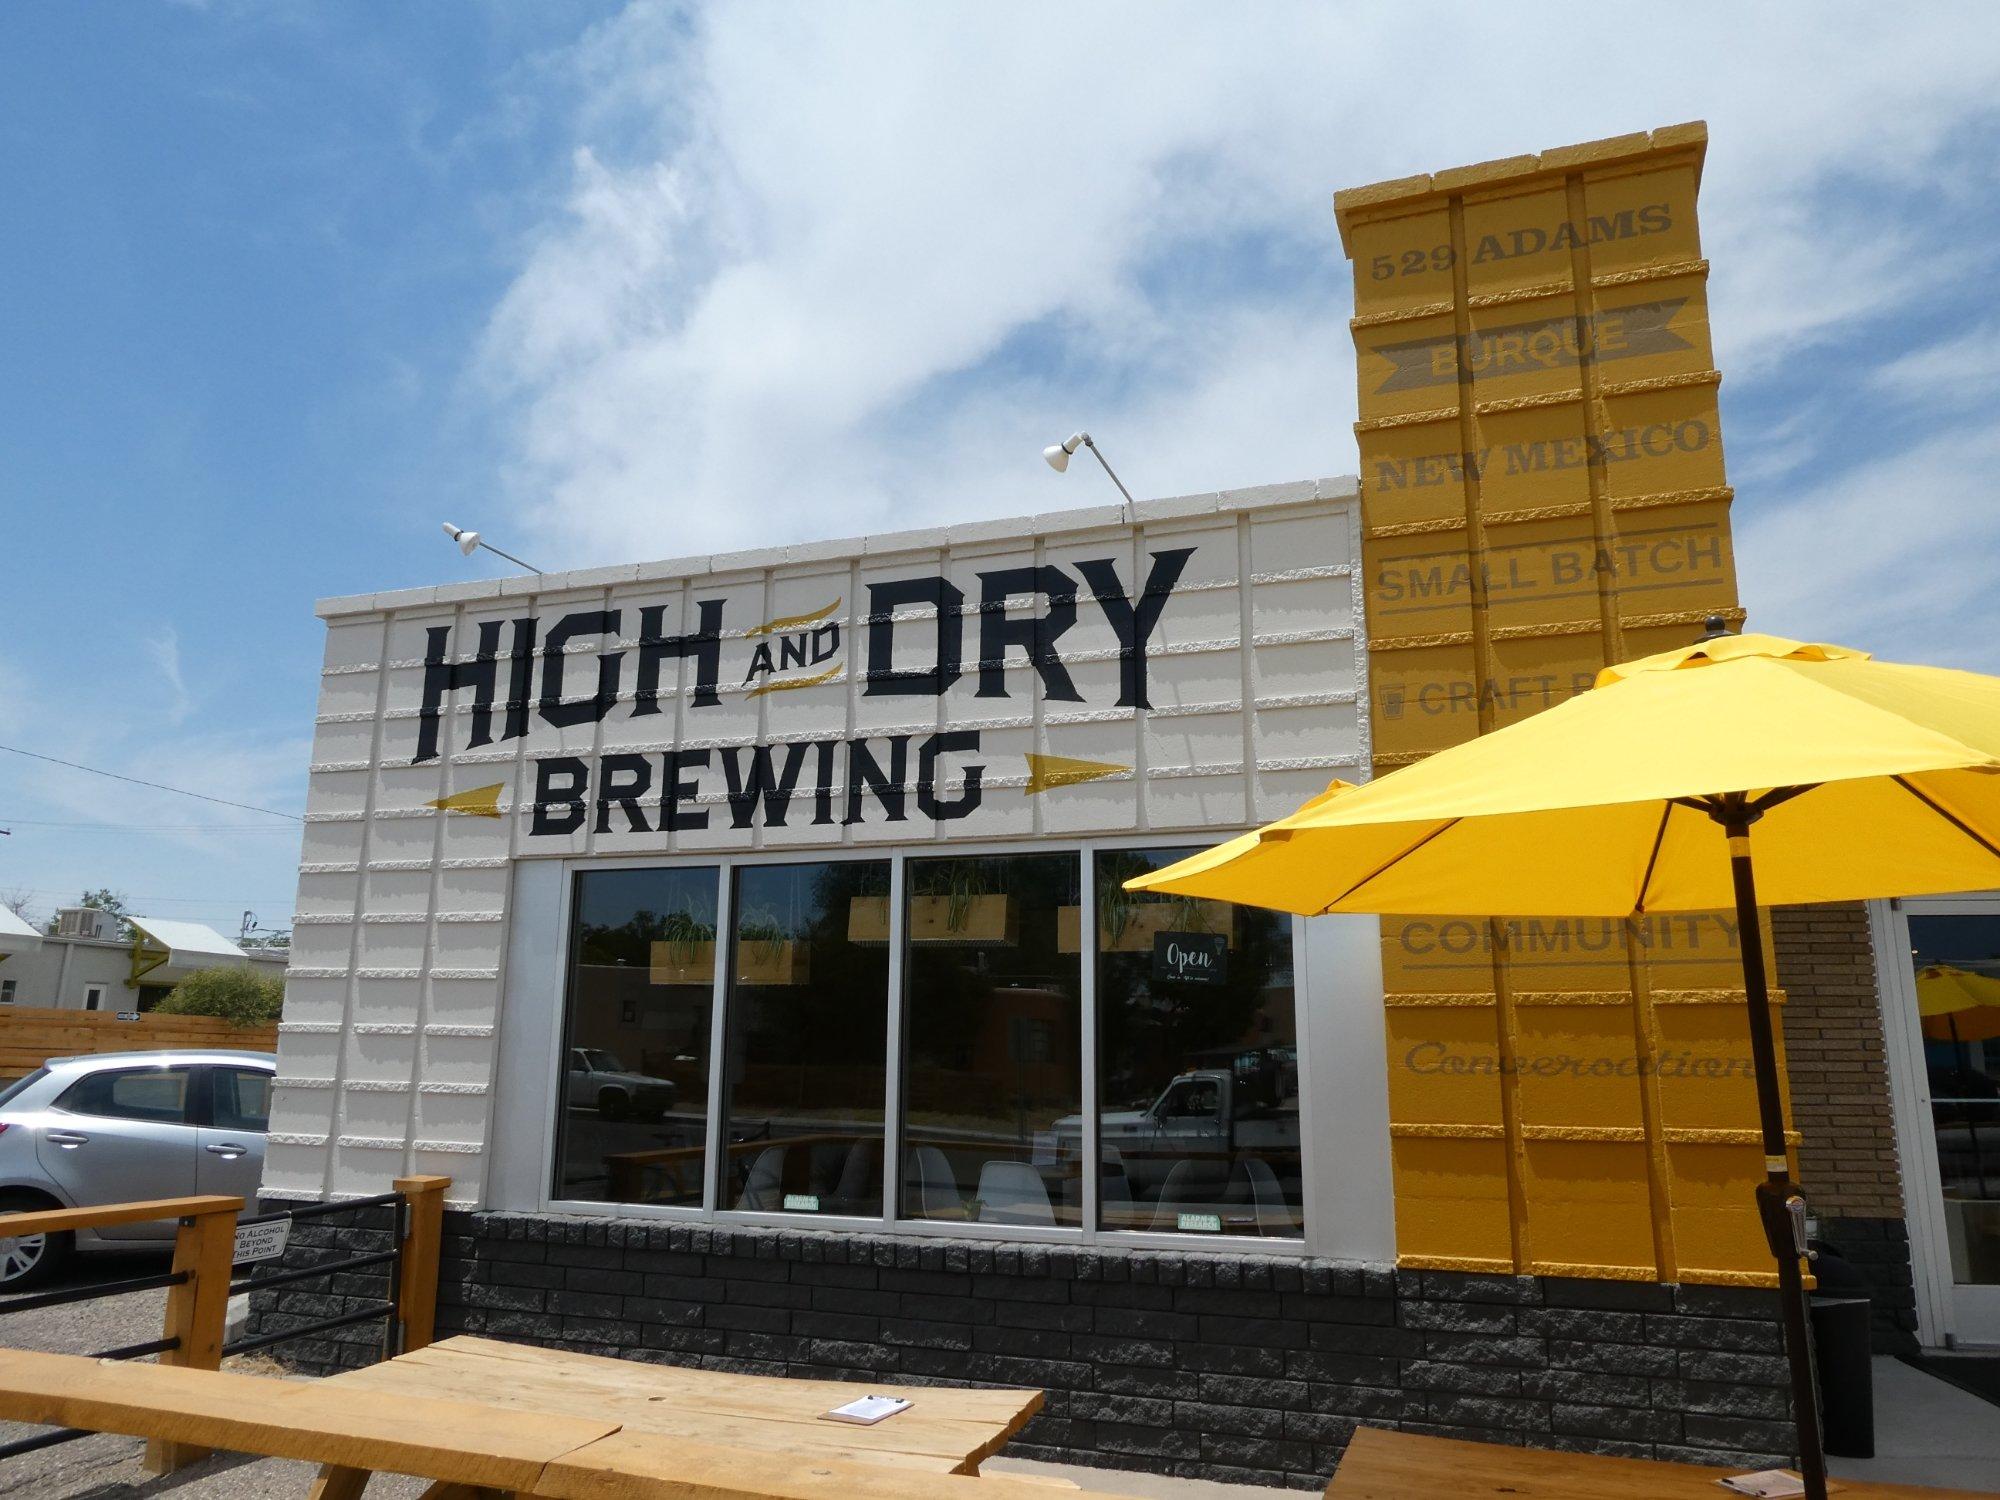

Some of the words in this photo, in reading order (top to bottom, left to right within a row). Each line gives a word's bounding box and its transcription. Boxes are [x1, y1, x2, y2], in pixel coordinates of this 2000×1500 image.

[1371, 245, 1457, 281] 529
[1471, 202, 1673, 265] ADAMS
[1431, 318, 1628, 377] BURQUE
[1376, 447, 1492, 492] NEW
[1505, 420, 1710, 476] MEXICO
[1377, 556, 1537, 602] SMALL
[1551, 537, 1722, 586] BATCH
[411, 598, 729, 766] HIGH
[742, 621, 841, 691] AND
[862, 546, 1198, 711] DRY
[1418, 674, 1558, 717] CRAFT
[529, 730, 984, 837] BREWING
[1167, 943, 1213, 973] Open
[1401, 913, 1741, 955] COMMUNITY
[240, 1238, 272, 1248] BEYOND
[247, 1227, 284, 1238] ALCOHOL
[252, 1246, 276, 1255] POINT
